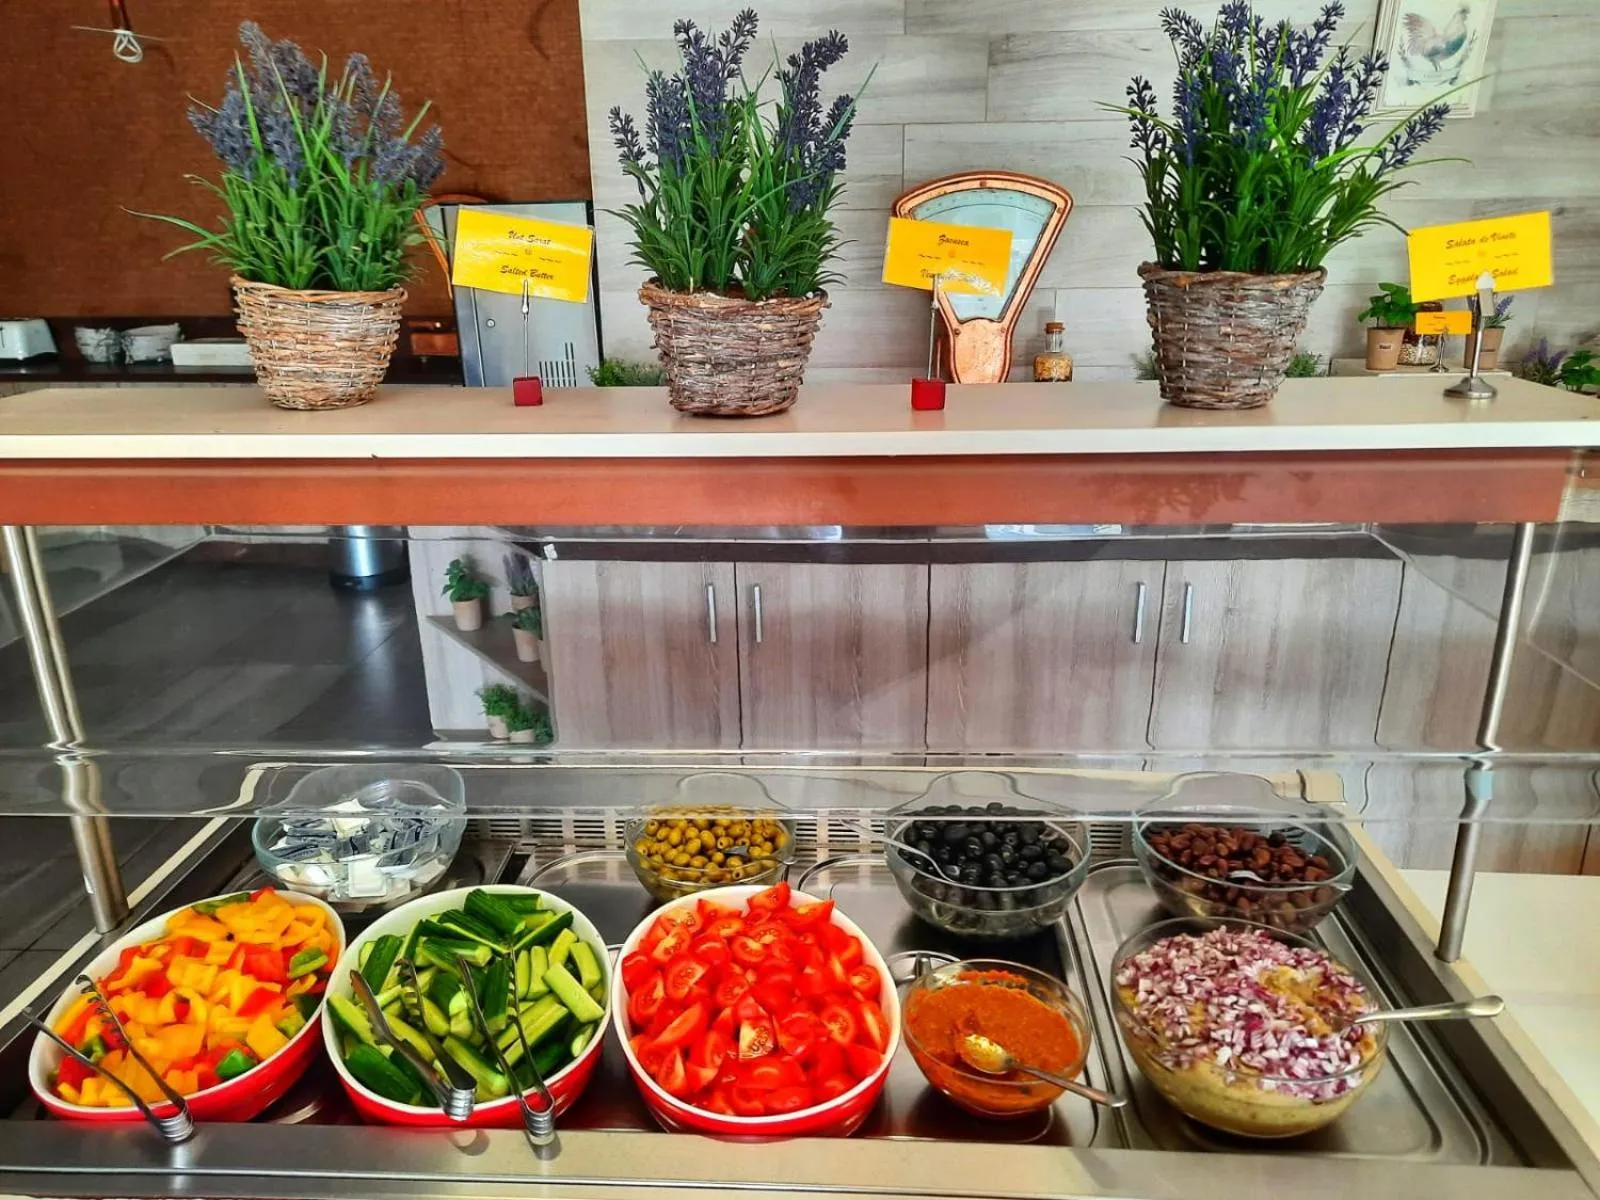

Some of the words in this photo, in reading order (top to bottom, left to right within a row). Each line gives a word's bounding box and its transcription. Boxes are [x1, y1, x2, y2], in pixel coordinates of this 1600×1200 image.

[500, 264, 528, 276] Salted
[530, 268, 554, 280] Butter
[1491, 267, 1519, 279] Salad
